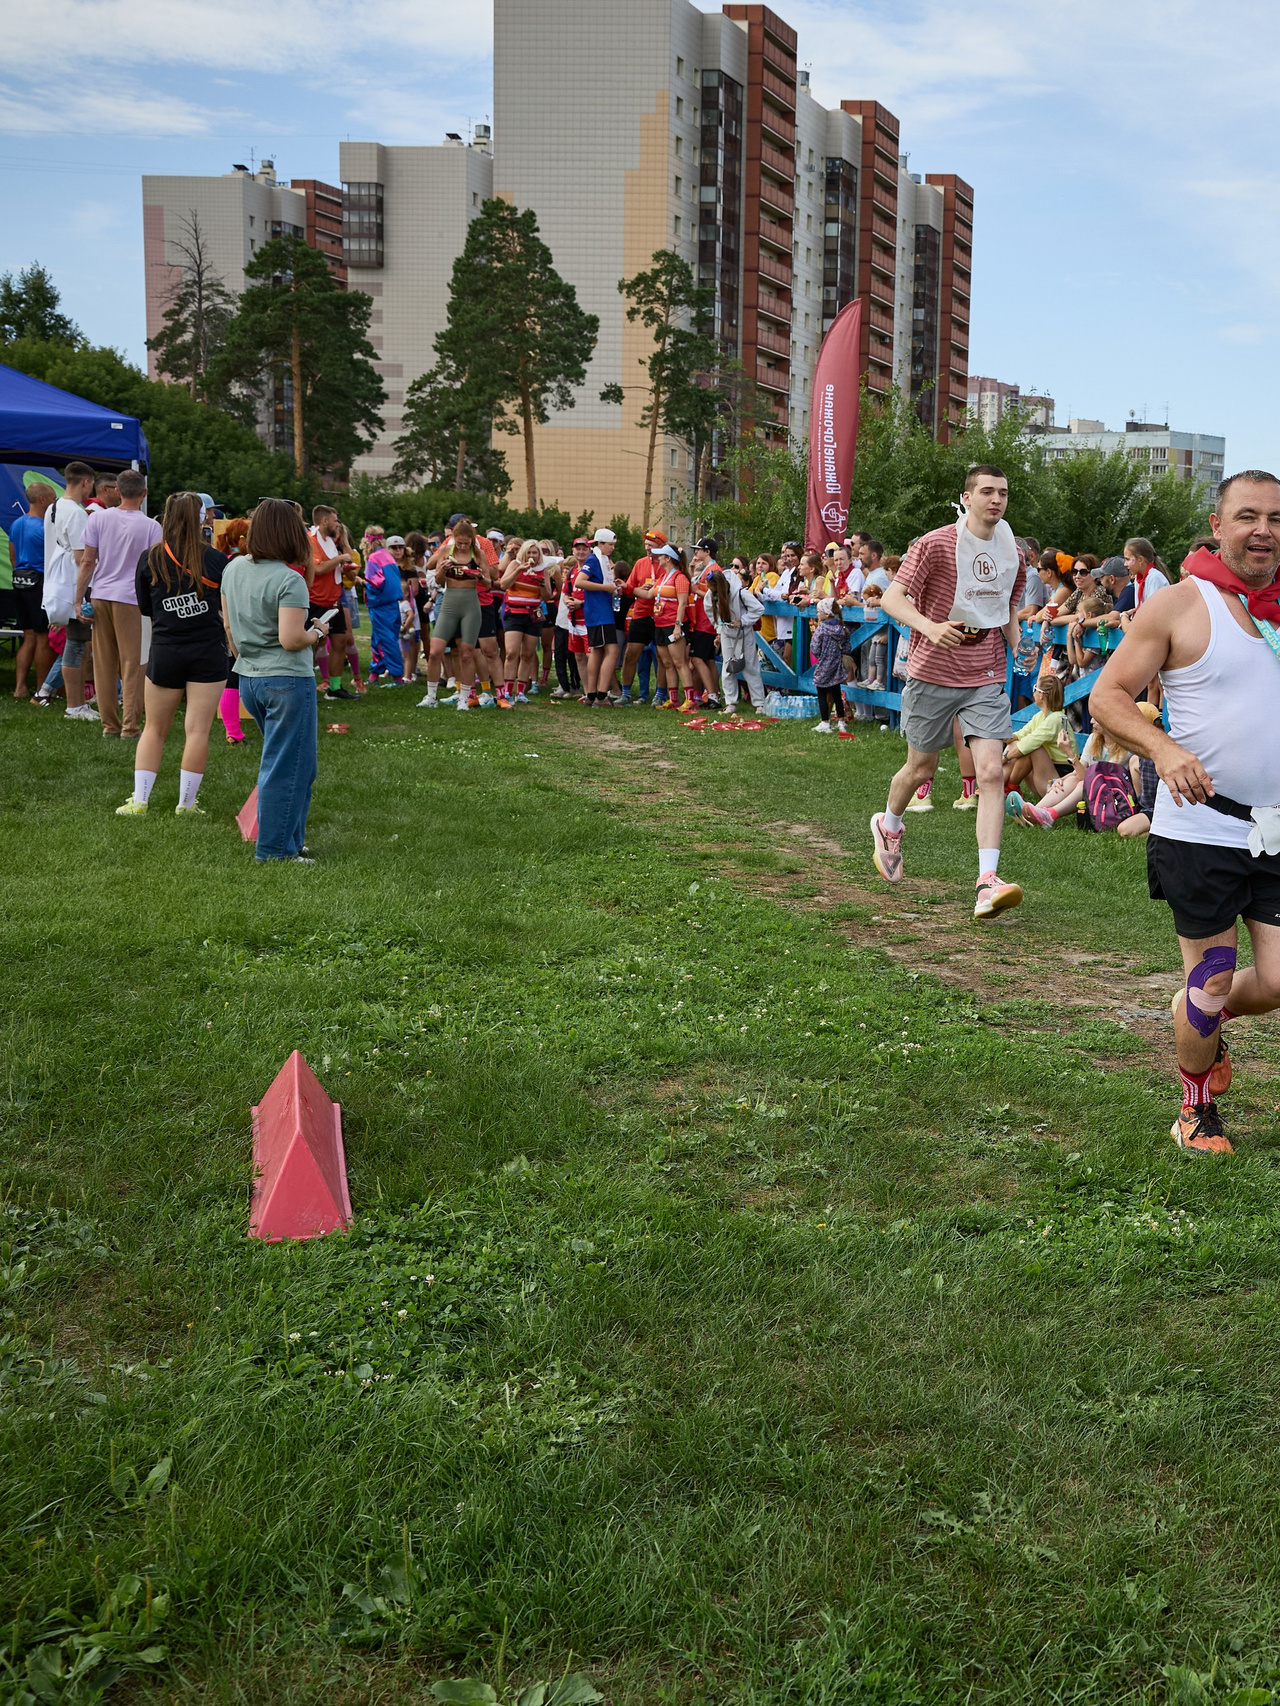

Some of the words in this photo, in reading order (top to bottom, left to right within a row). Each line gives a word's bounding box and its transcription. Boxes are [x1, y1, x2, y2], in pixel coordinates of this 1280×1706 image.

[977, 560, 994, 576] 18+
[163, 593, 198, 610] СПОРТ
[177, 602, 207, 617] СОЮЗ
